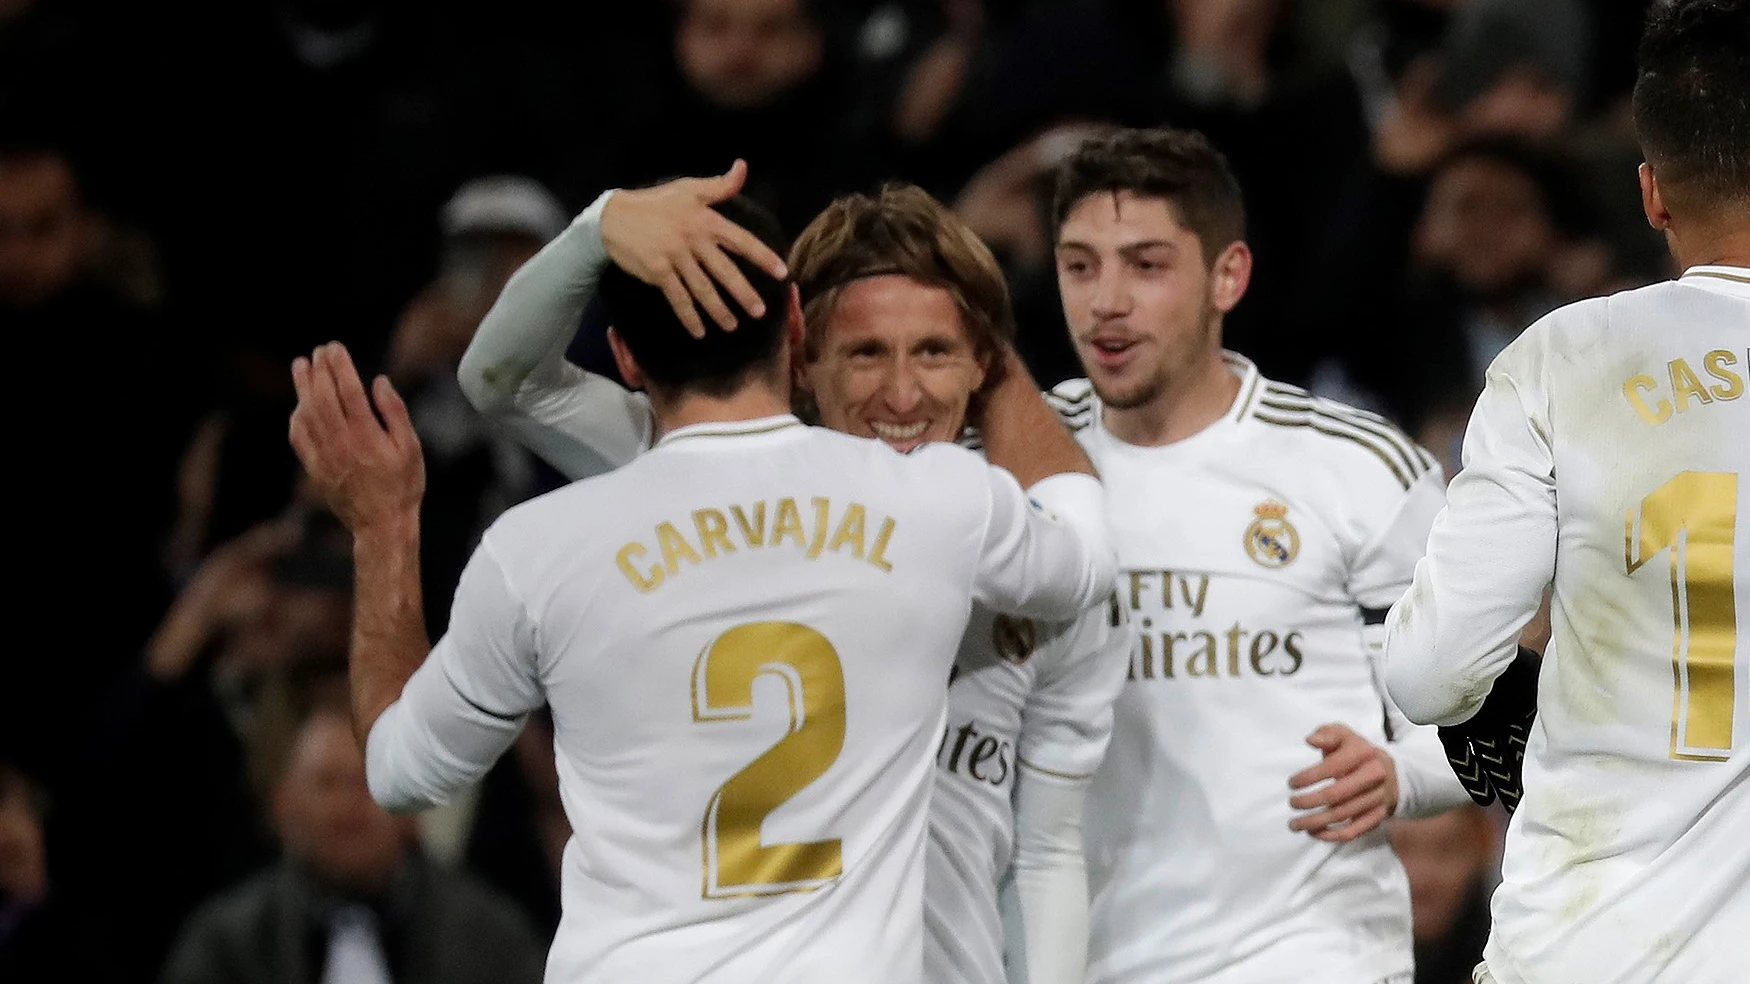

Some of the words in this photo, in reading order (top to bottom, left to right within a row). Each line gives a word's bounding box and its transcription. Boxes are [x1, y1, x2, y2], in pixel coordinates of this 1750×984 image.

[616, 496, 897, 594] CARVAJAL
[1124, 618, 1304, 682] irates
[690, 620, 847, 900] 2
